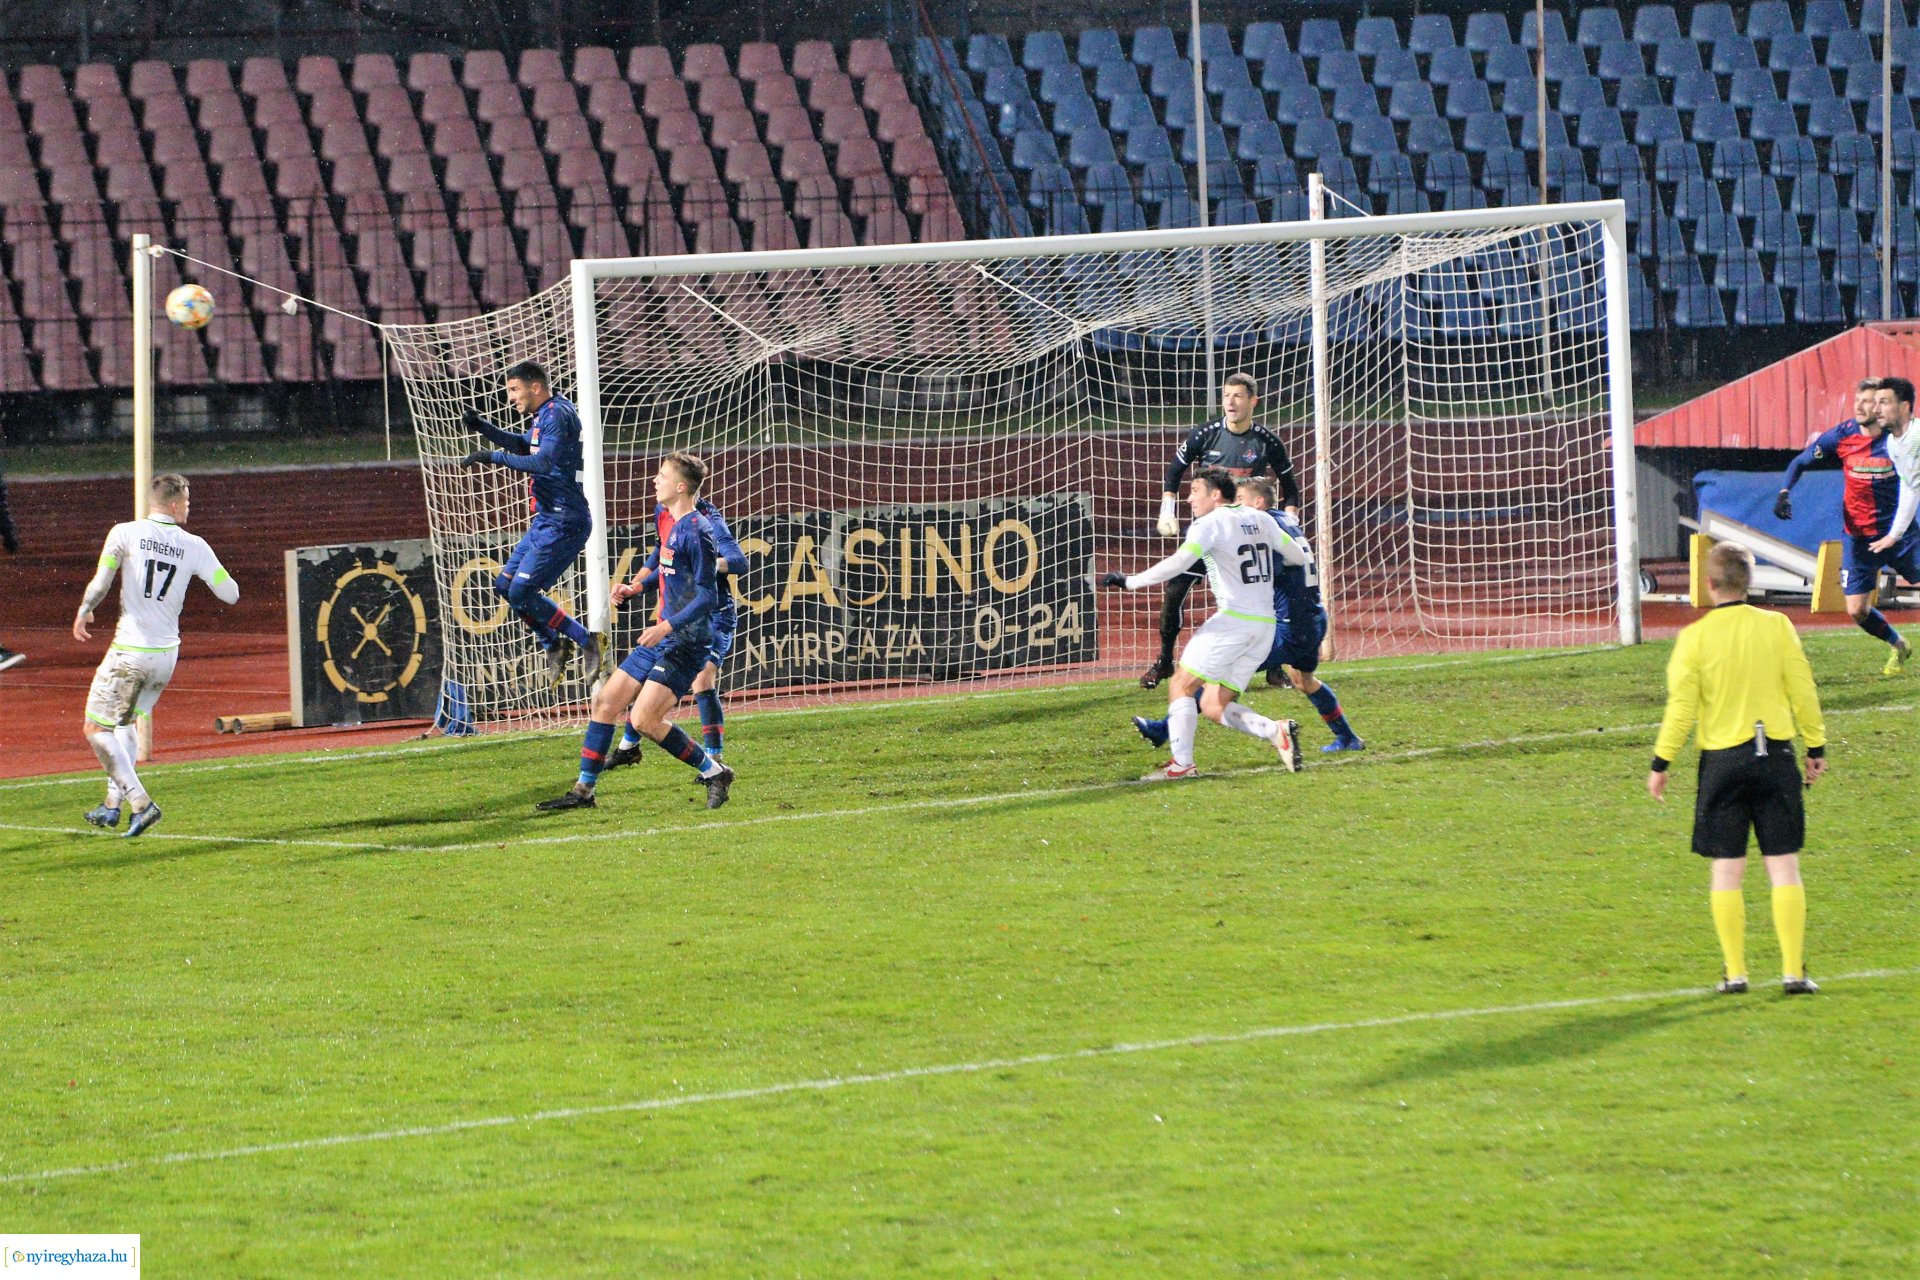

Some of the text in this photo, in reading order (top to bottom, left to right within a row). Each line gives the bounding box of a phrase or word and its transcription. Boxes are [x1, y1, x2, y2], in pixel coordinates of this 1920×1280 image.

[144, 558, 177, 601] 17
[727, 519, 1039, 615] CASINO
[1237, 542, 1271, 584] 20
[973, 602, 1083, 651] 0-24
